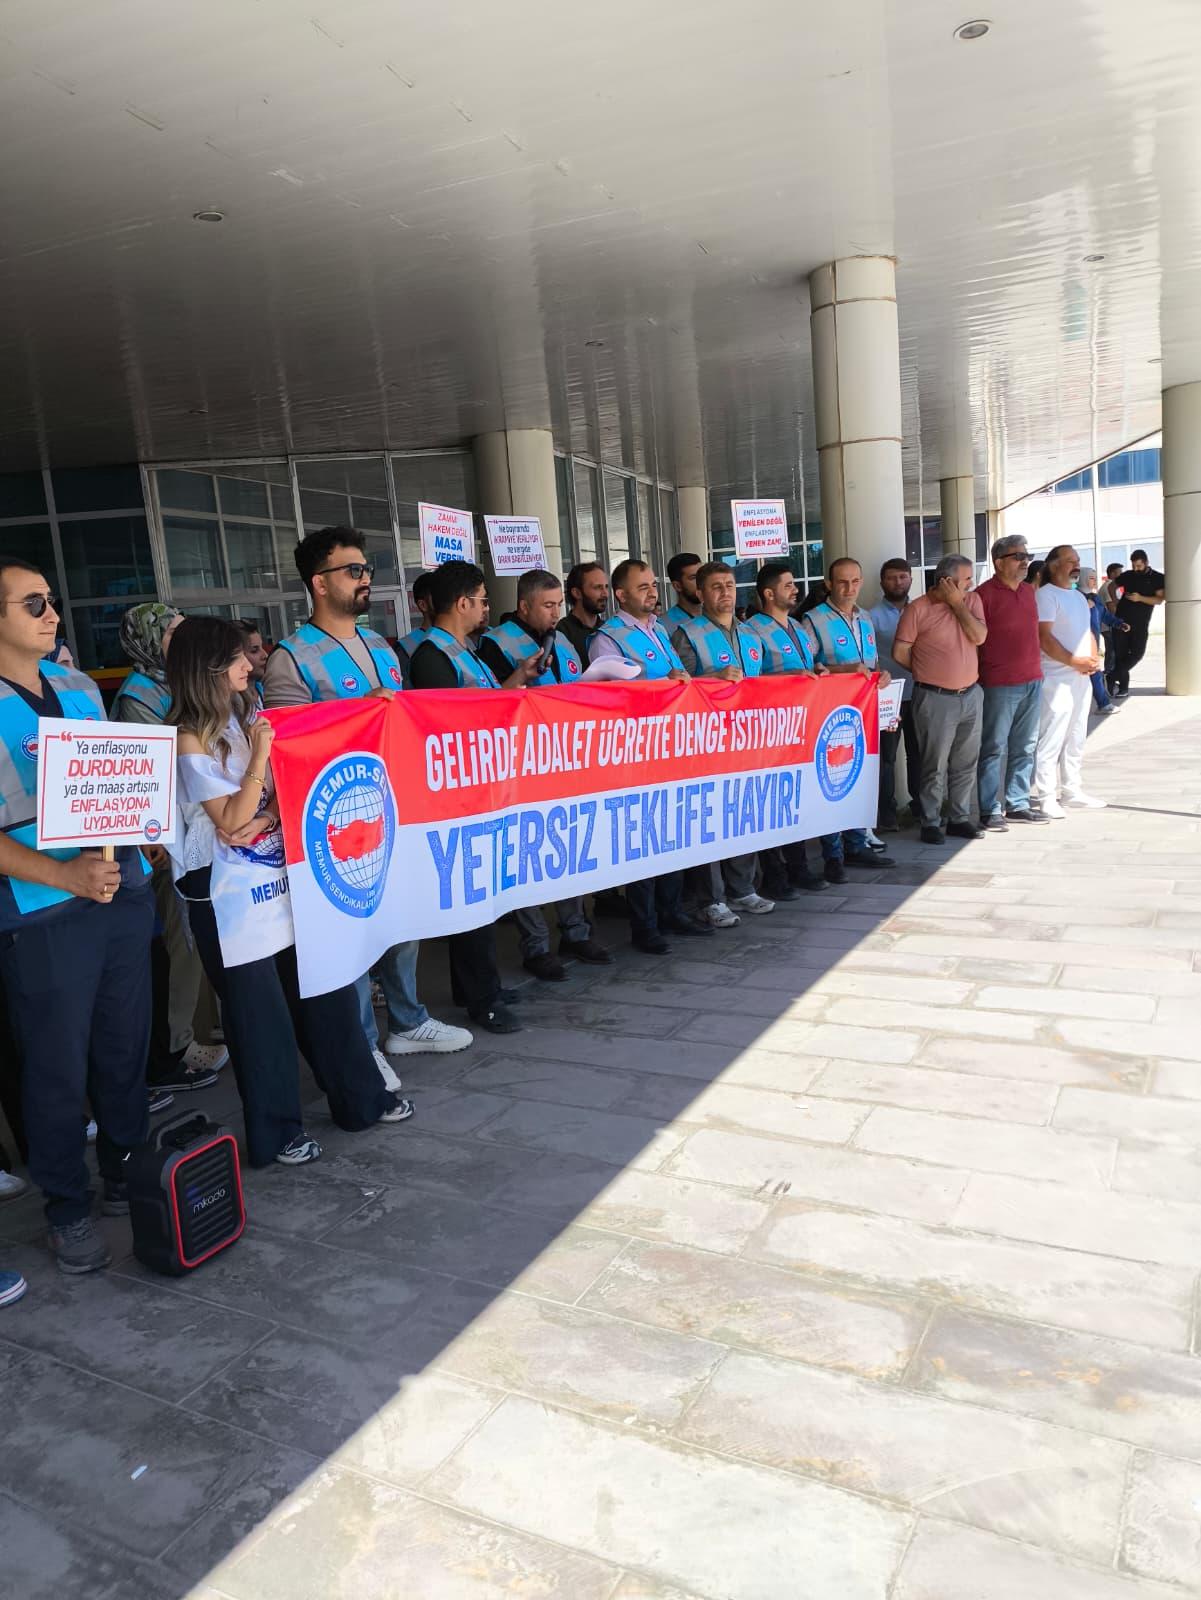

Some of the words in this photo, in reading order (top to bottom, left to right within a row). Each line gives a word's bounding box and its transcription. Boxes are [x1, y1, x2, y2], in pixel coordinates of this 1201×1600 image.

[427, 523, 451, 535] HAKEM
[434, 535, 463, 552] MASA
[76, 740, 89, 755] Ya
[91, 740, 148, 757] enflasyonu
[425, 725, 519, 792] GELİRDE
[521, 720, 596, 777] ADALET
[597, 714, 671, 767] ÜCRETTE
[674, 710, 728, 758] DENGE
[730, 705, 808, 752] İSTİYORUZ!
[68, 758, 154, 778] DURDURUN
[64, 784, 78, 799] ya
[80, 781, 94, 795] da
[96, 782, 125, 796] maaş
[71, 796, 151, 814] ENFLASYONA
[83, 813, 141, 832] UYDURUN
[426, 800, 598, 910] YETERSİZ
[604, 781, 716, 865] TEKLİFE
[723, 769, 802, 840] HAYIR!
[314, 840, 332, 885] MEMUR
